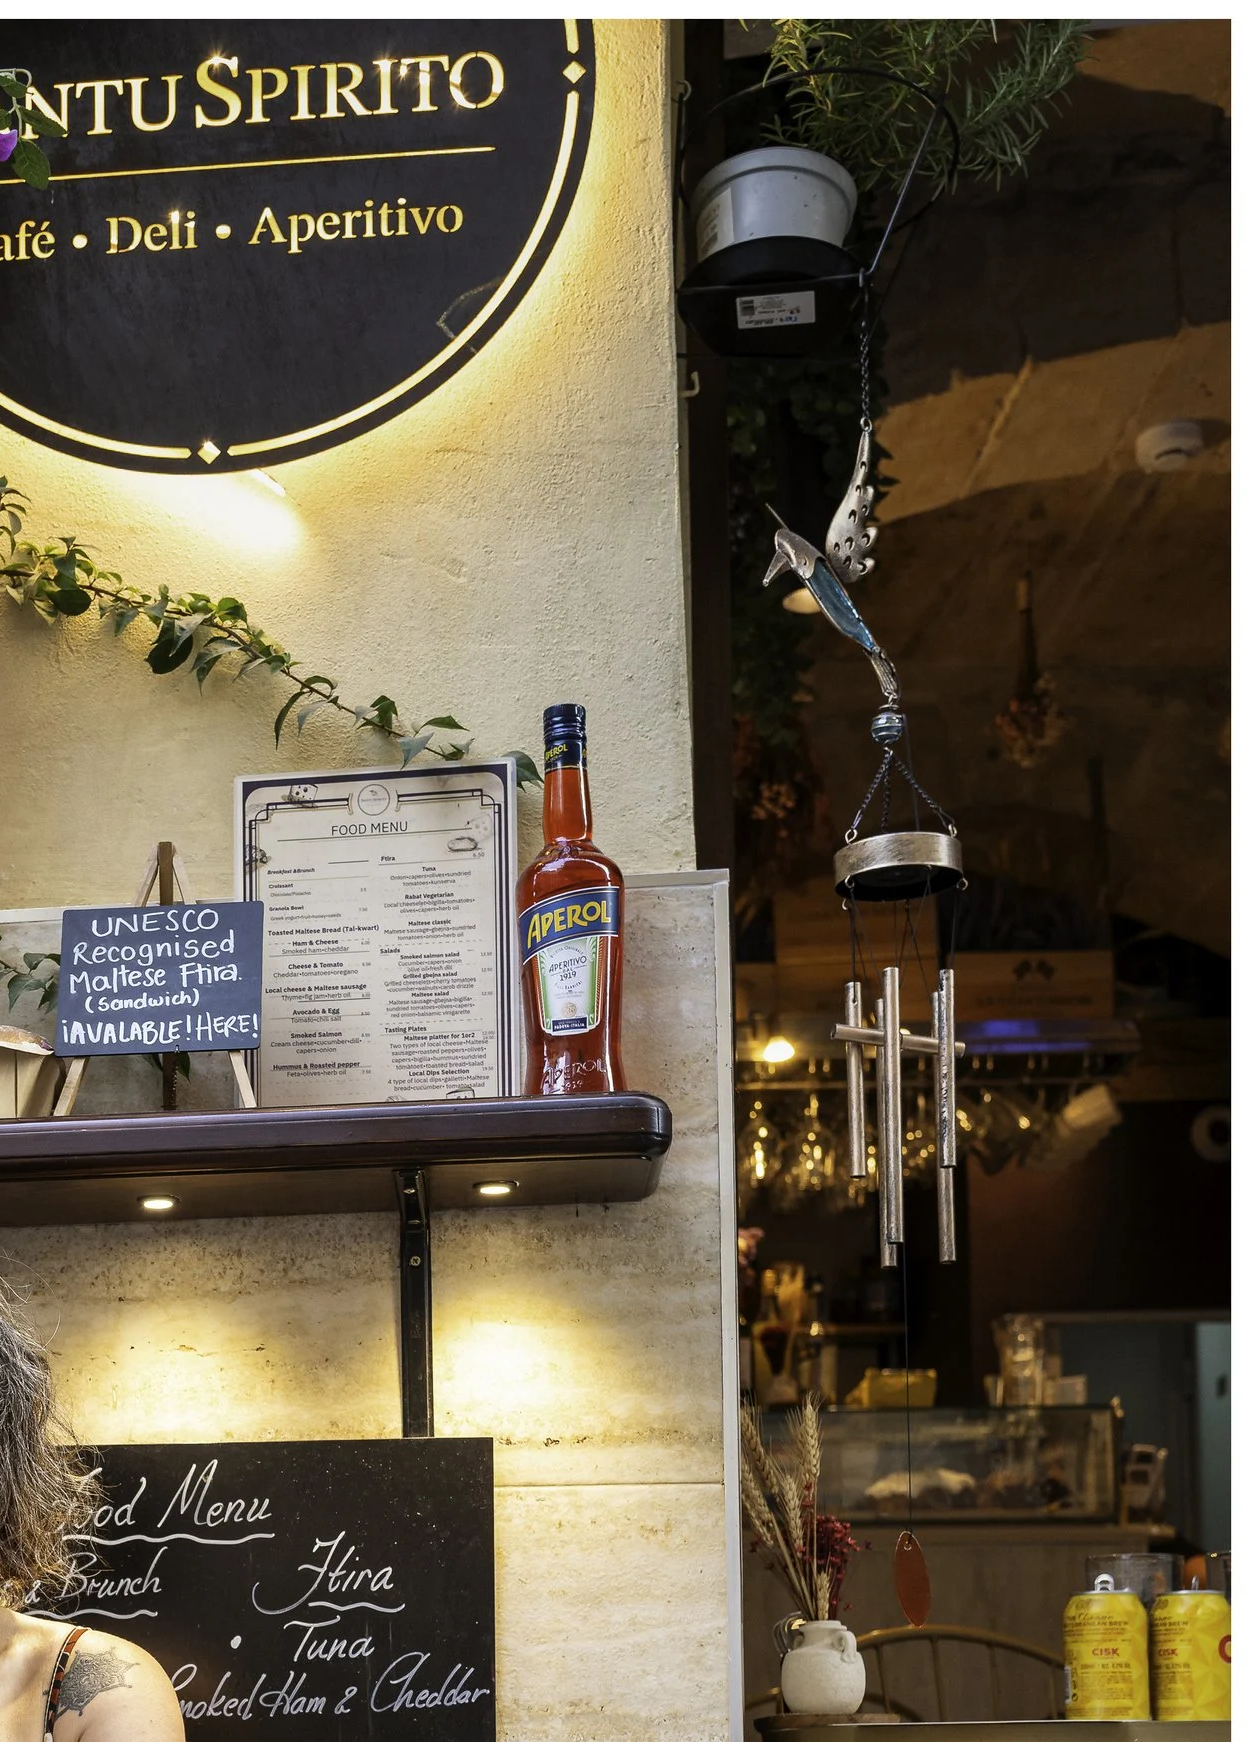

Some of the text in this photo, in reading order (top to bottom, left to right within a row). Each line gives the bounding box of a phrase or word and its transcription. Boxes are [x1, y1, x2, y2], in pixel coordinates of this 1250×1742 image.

[105, 210, 198, 256] Deli
[250, 198, 464, 255] Aperitivo
[331, 821, 408, 836] FOOD MENU
[91, 909, 219, 937] UNESCO
[527, 900, 611, 950] APEROL
[73, 929, 234, 966] Recognised
[548, 955, 587, 973] APERITIVO
[70, 964, 166, 994] Maltese
[560, 970, 577, 981] 1919
[157, 1459, 271, 1529] Menu
[55, 1546, 168, 1601] Brunch
[284, 1615, 375, 1662] Tuna
[1091, 1647, 1120, 1657] CISK
[259, 1669, 323, 1719] Ham
[371, 1651, 490, 1715] Cheddar
